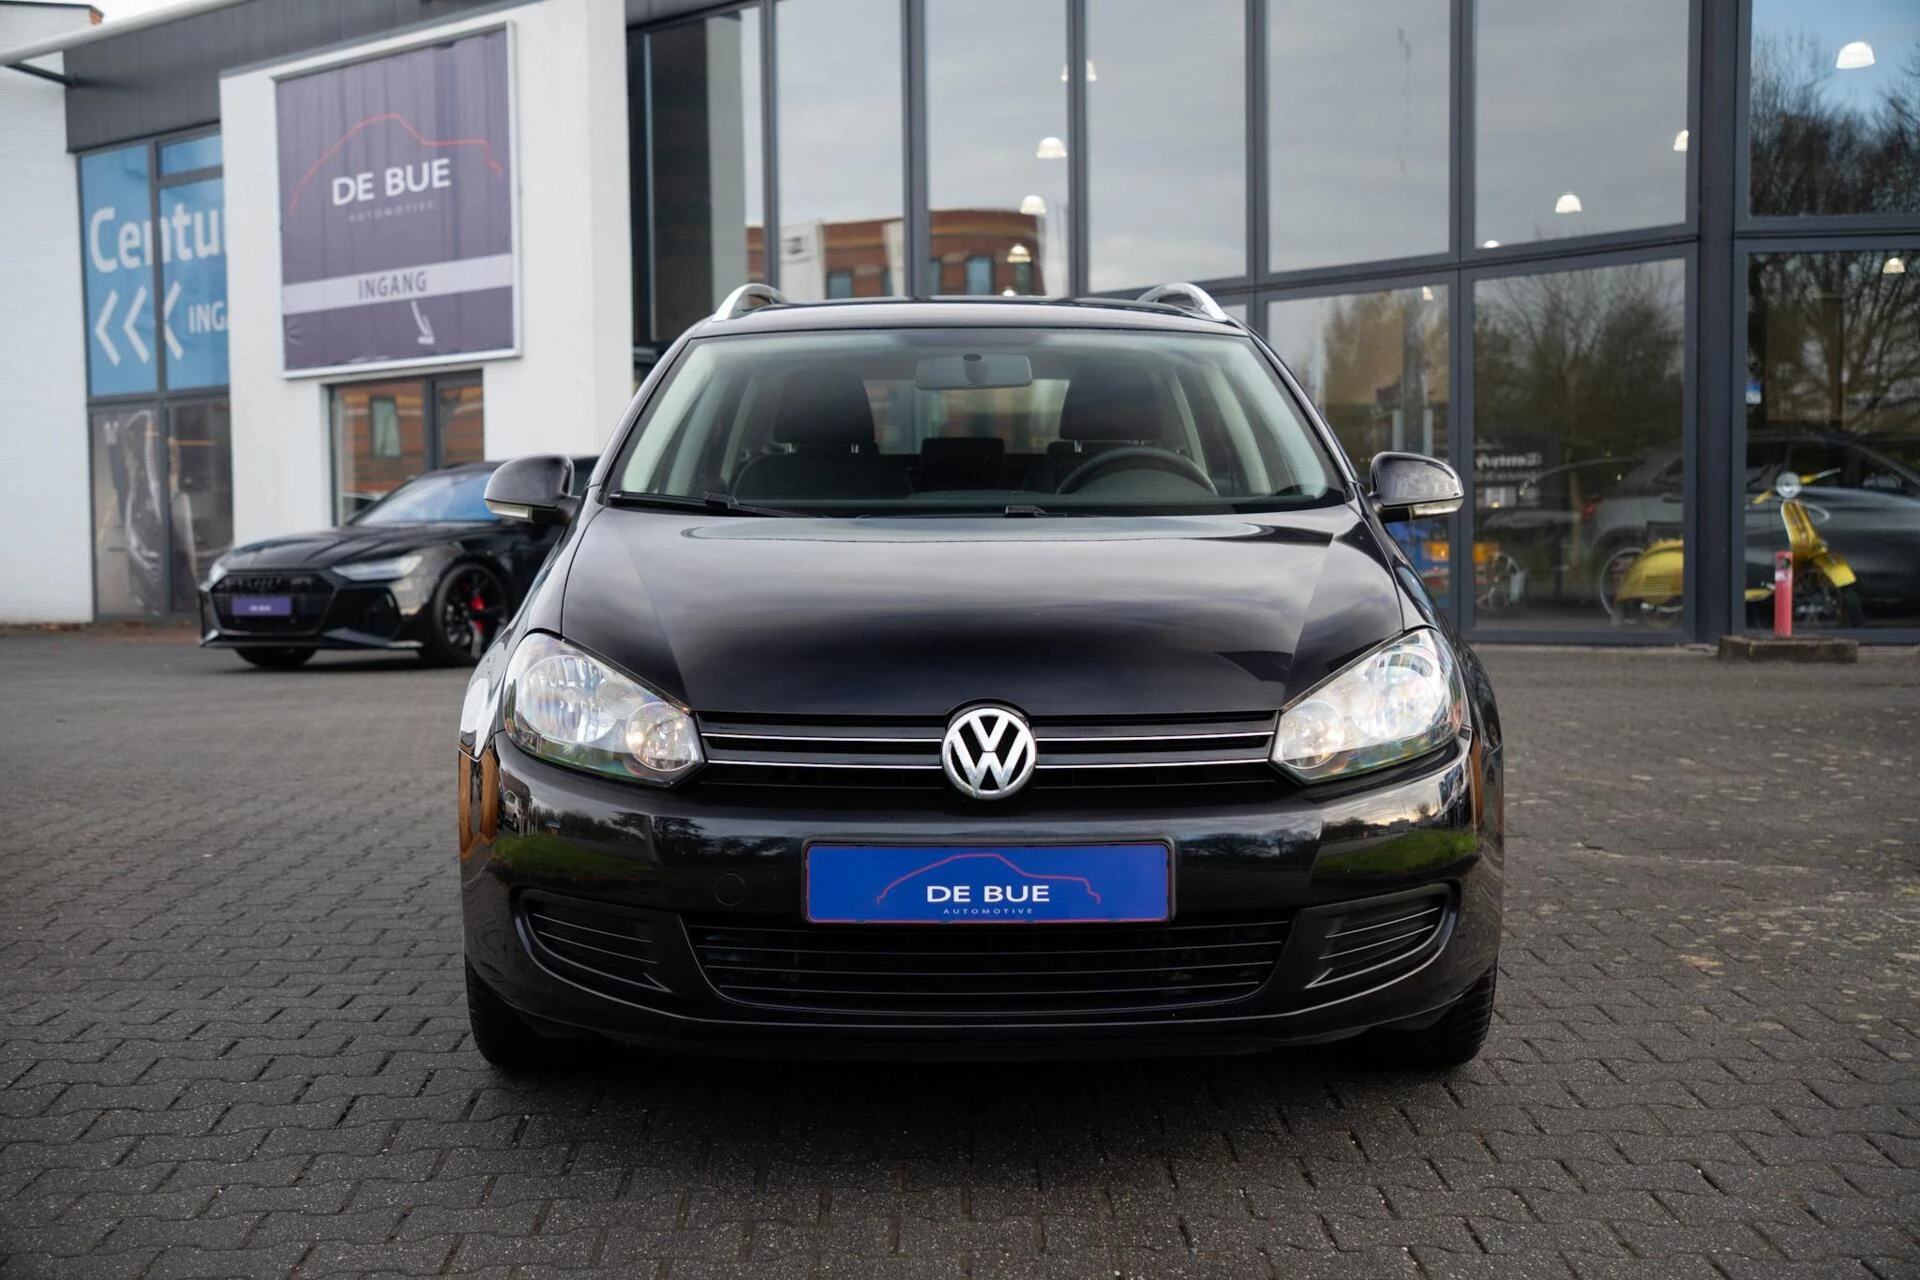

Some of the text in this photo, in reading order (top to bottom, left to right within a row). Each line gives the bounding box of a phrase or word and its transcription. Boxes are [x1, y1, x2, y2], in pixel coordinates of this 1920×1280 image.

[332, 157, 451, 206] DE BUE
[90, 203, 226, 272] Centu
[358, 271, 428, 299] INGANG
[188, 301, 229, 334] ING
[927, 885, 1050, 902] DE BUE
